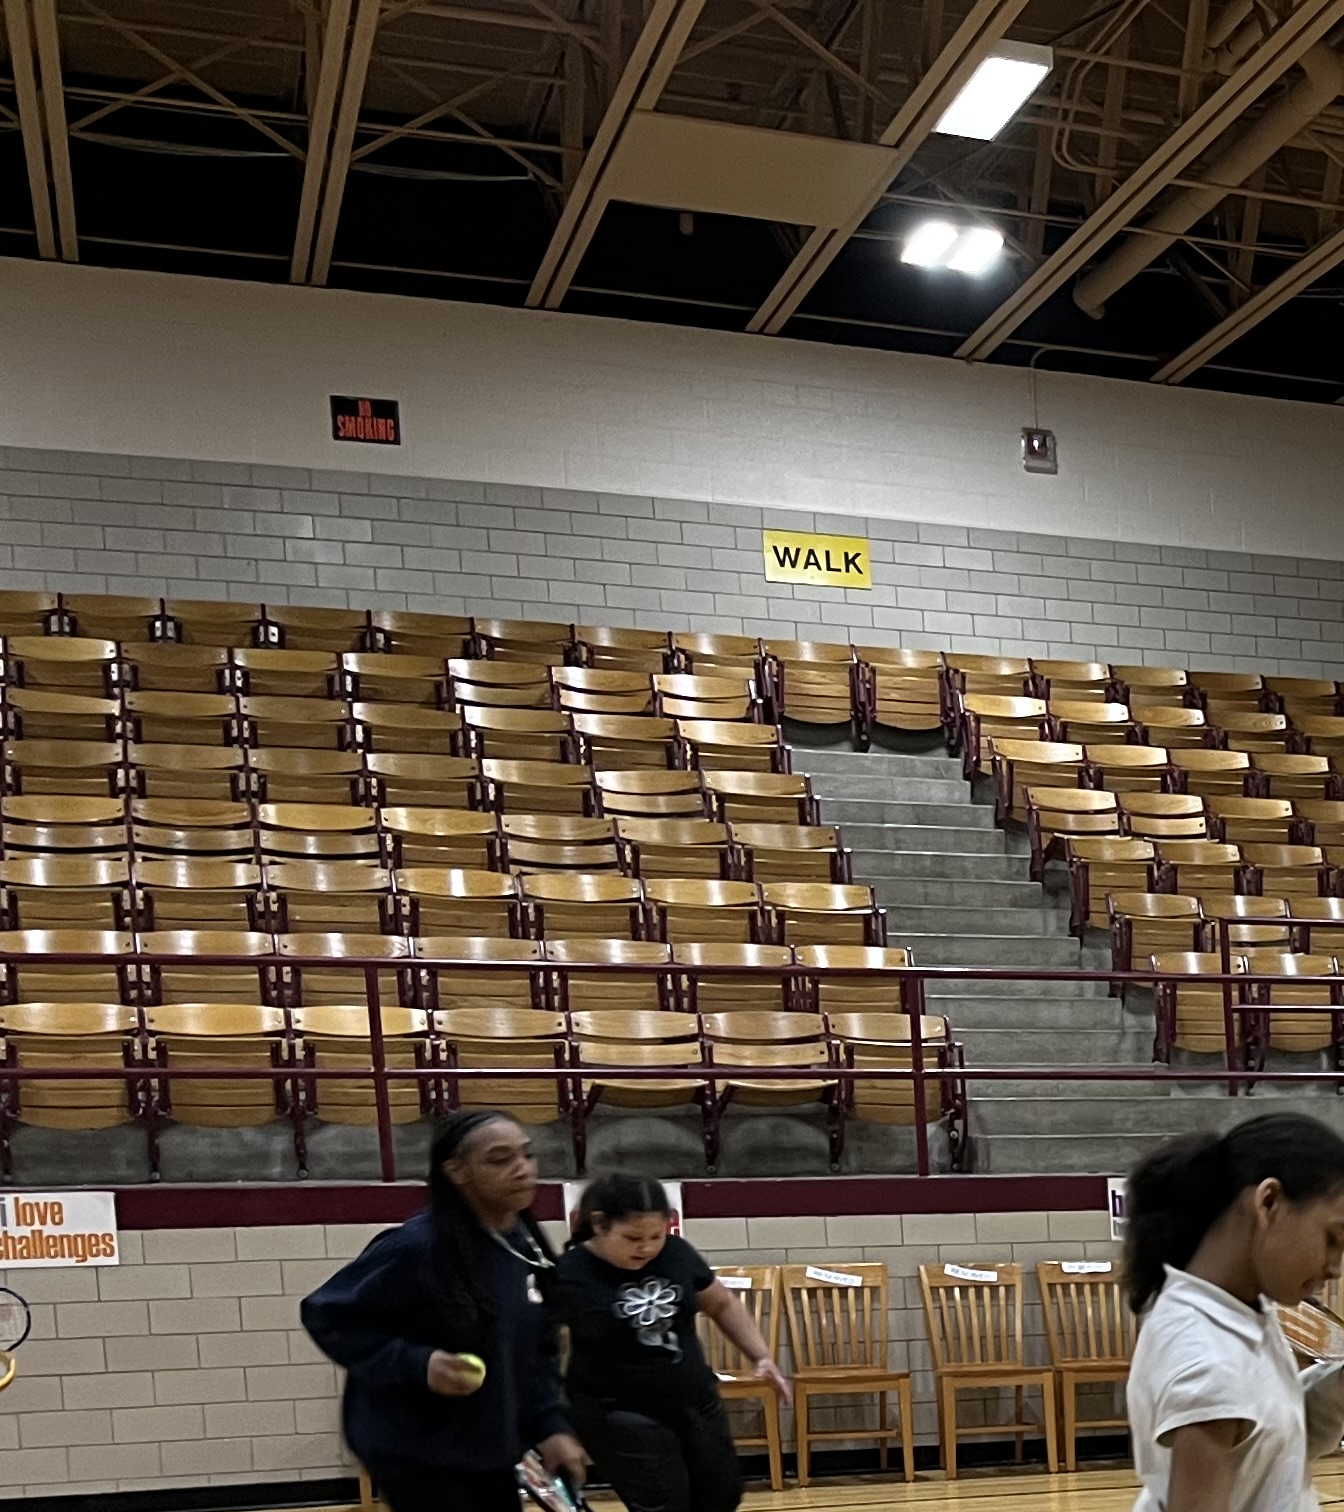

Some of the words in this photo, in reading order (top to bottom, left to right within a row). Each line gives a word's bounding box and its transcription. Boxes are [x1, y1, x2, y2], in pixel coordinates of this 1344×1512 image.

[337, 415, 395, 441] SMOKING
[772, 545, 863, 575] WALK
[13, 1196, 64, 1227] love
